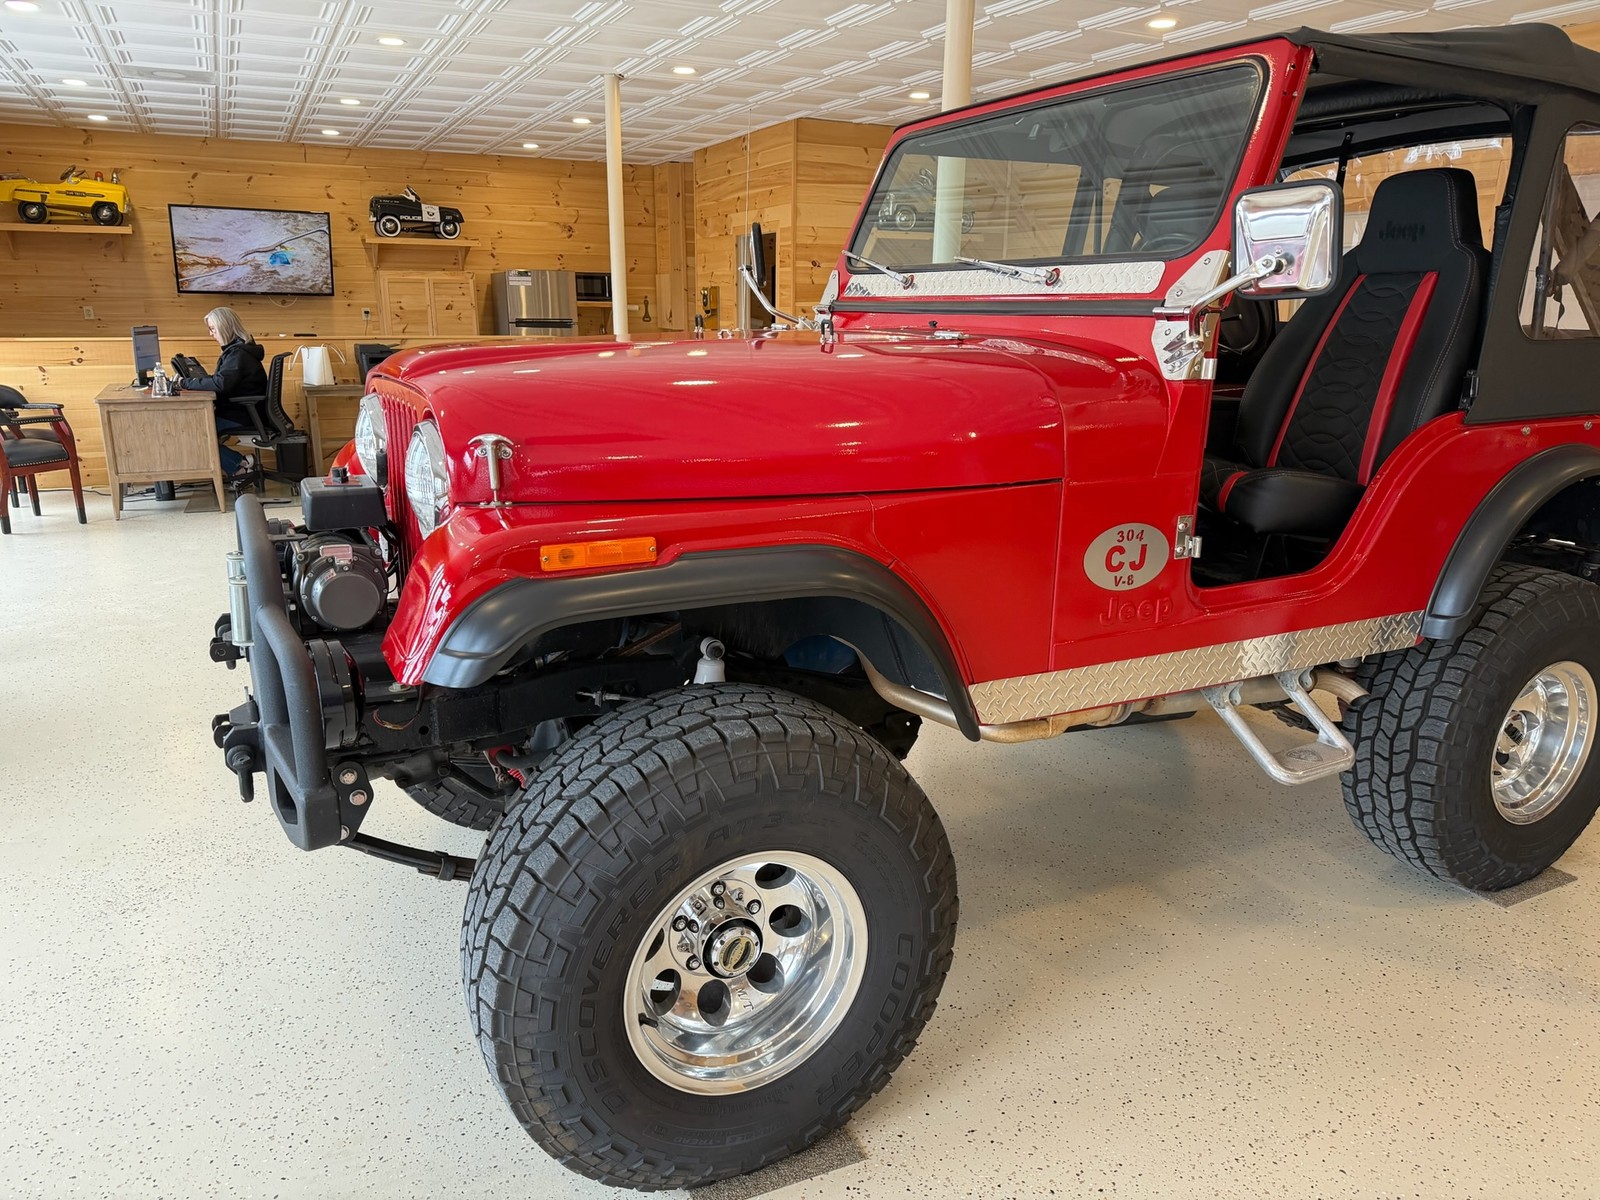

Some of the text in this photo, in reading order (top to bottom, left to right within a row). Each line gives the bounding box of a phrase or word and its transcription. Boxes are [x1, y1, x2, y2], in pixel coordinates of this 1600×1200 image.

[1116, 529, 1145, 543] 304
[1105, 543, 1148, 573] CJ
[1113, 574, 1134, 587] V-8
[1099, 597, 1173, 626] Jeep
[577, 853, 682, 1116] DISCOVERER
[734, 987, 756, 1012] M/T
[815, 932, 915, 1106] COOPER
